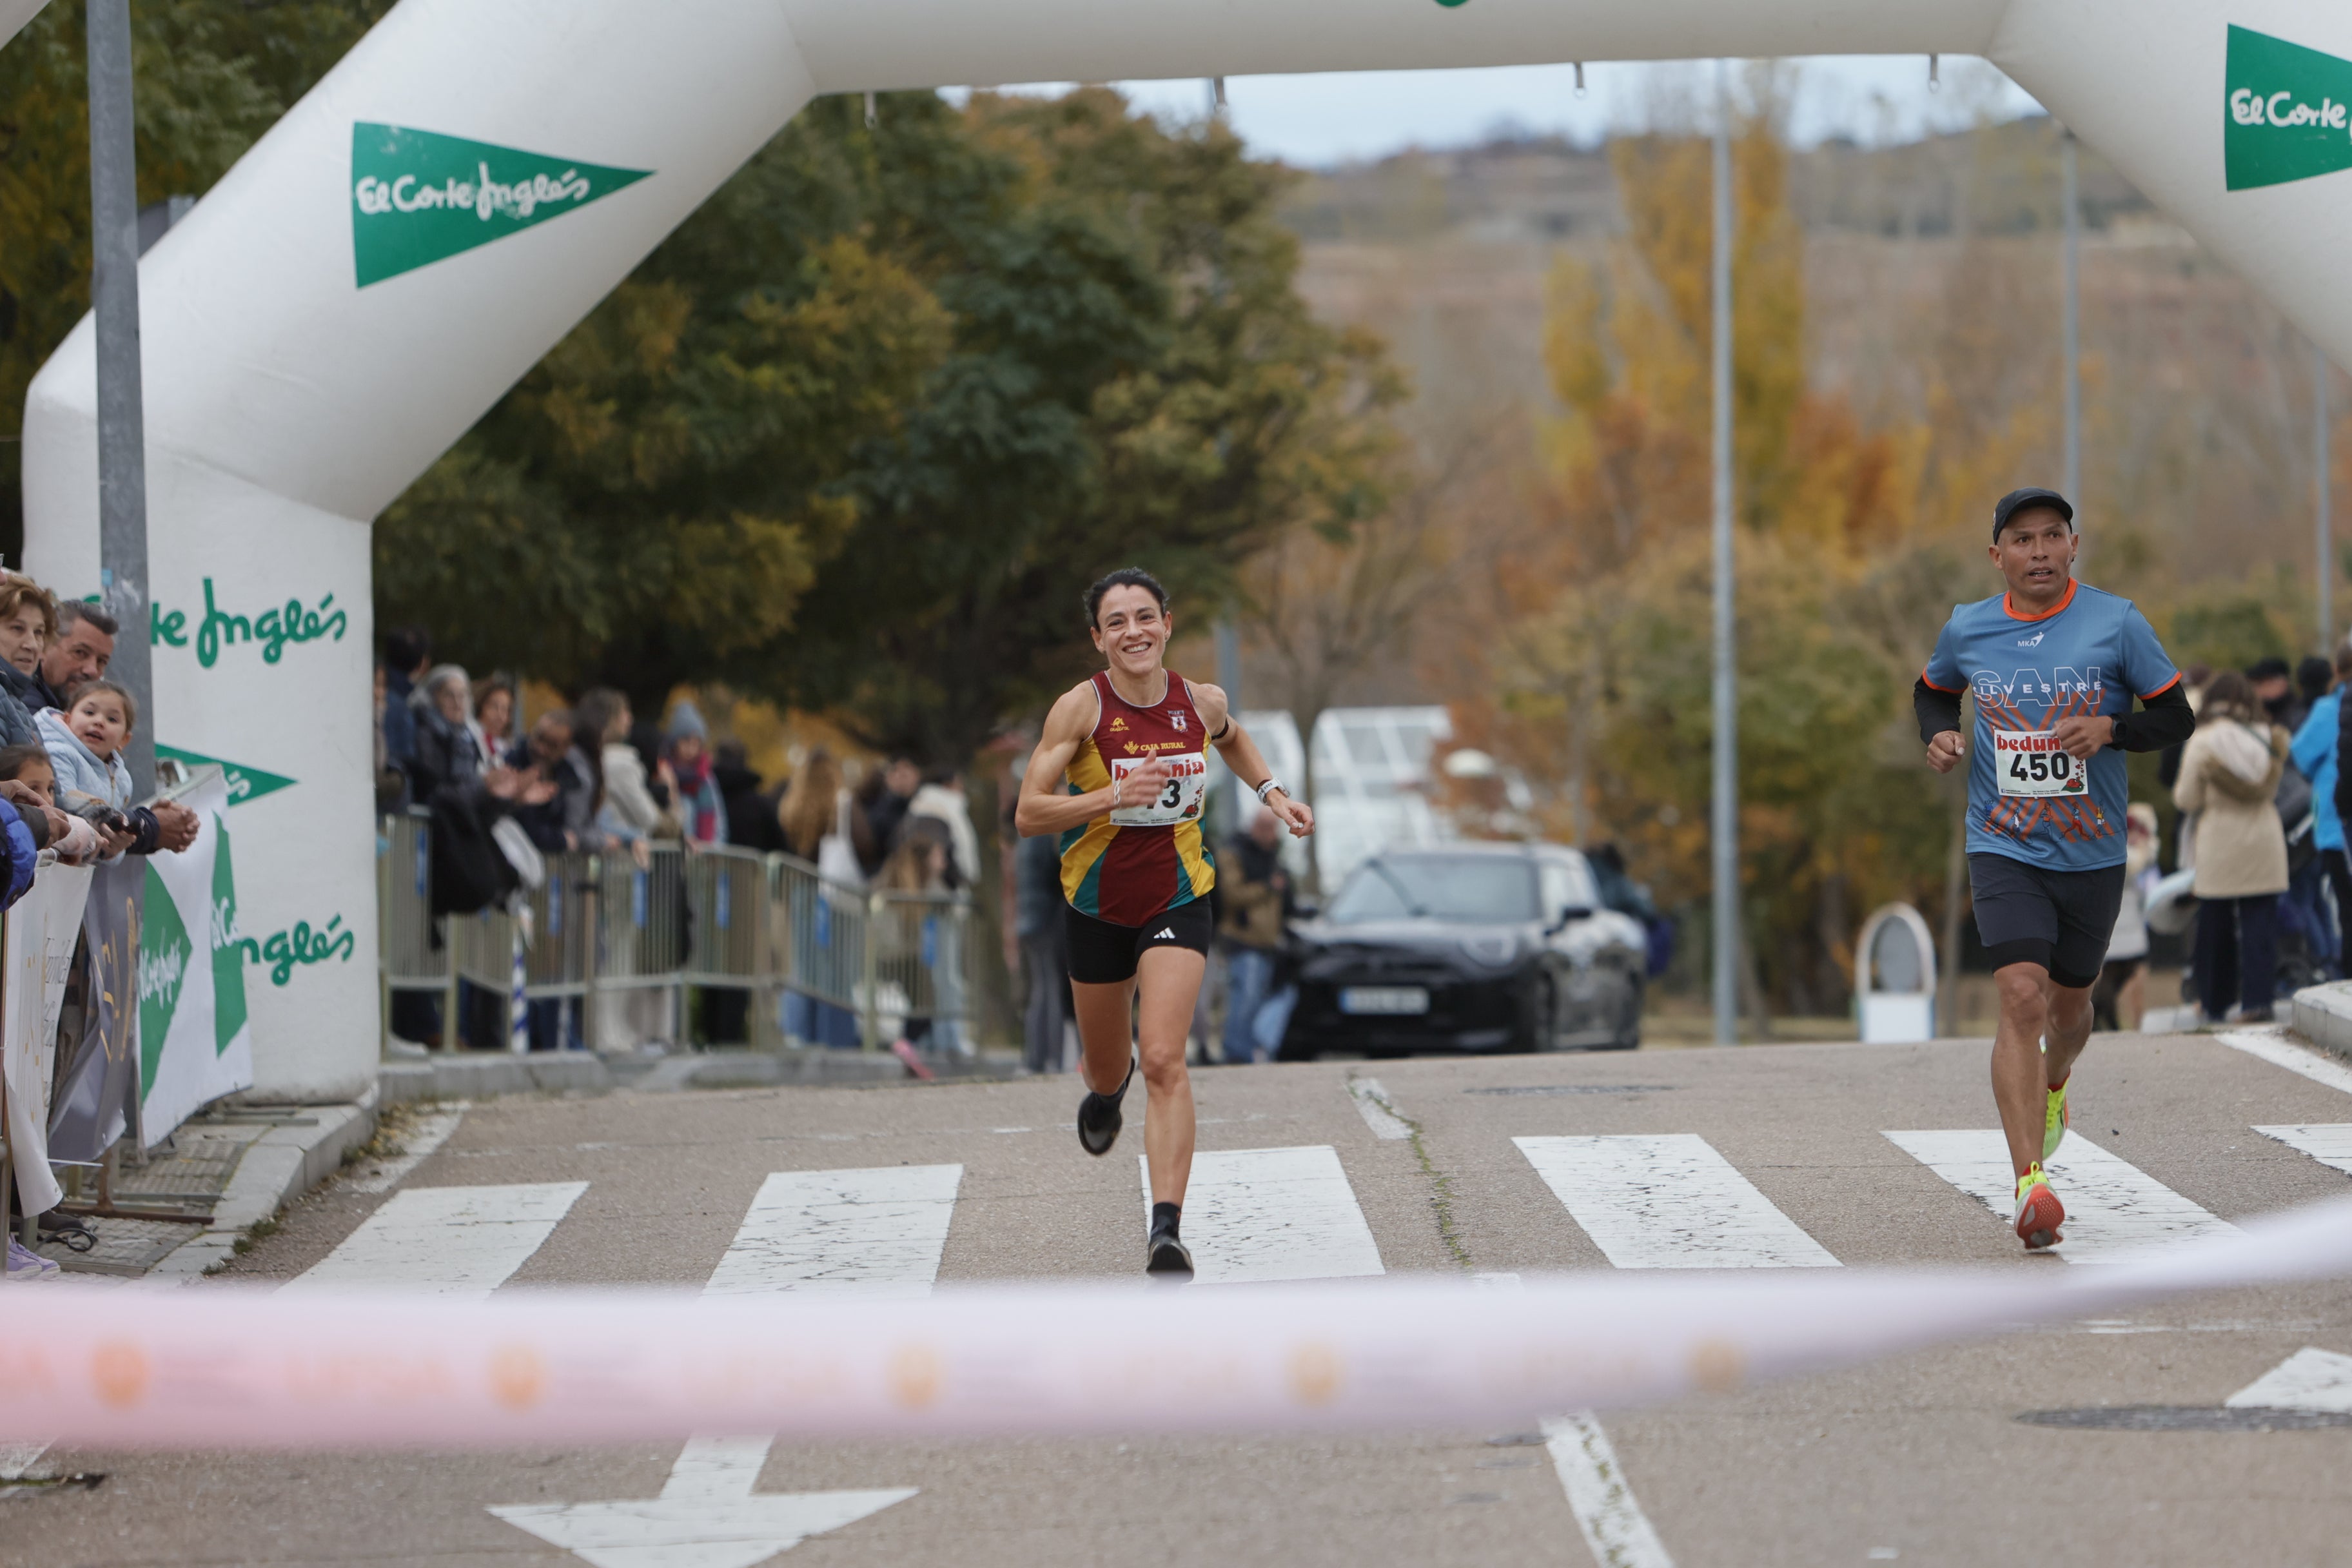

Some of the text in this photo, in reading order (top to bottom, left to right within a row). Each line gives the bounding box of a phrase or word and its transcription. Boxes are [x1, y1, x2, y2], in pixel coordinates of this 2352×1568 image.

[2230, 88, 2347, 129] El Corte
[355, 161, 591, 221] El Corte Inglés
[1971, 667, 2101, 709] SAN
[1161, 741, 1186, 750] RURAL
[1996, 734, 2061, 752] bedun
[1114, 759, 1204, 781] bnia
[2010, 752, 2070, 782] 450
[240, 912, 355, 986] nglés
